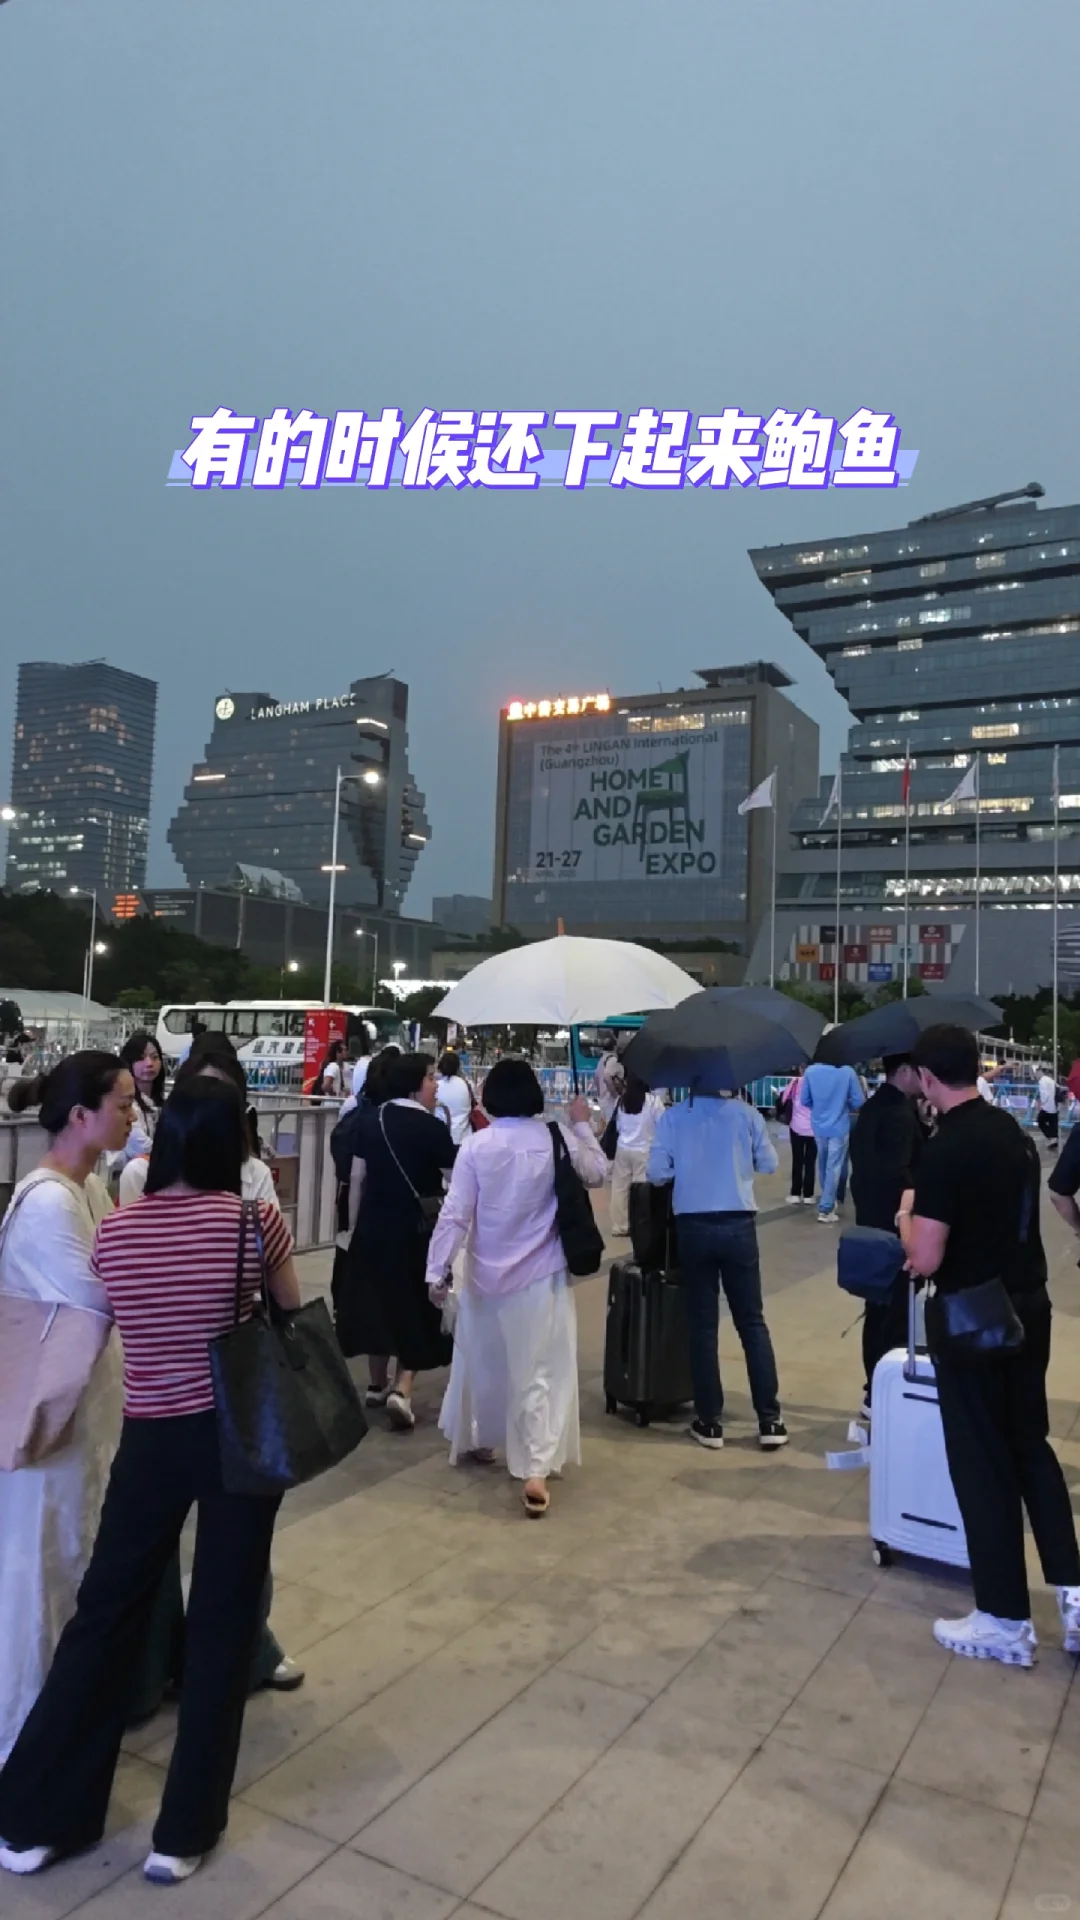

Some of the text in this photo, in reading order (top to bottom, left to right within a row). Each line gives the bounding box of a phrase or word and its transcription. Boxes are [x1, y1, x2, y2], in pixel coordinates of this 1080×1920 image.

[250, 692, 357, 721] LANGHAM PLACE
[541, 744, 562, 757] The
[582, 737, 632, 755] LINGAN
[632, 731, 719, 749] International
[590, 767, 663, 793] HOME
[573, 795, 632, 820] AND
[593, 819, 706, 847] GARDEN
[535, 850, 583, 868] 21-27
[645, 851, 716, 875] EXPO
